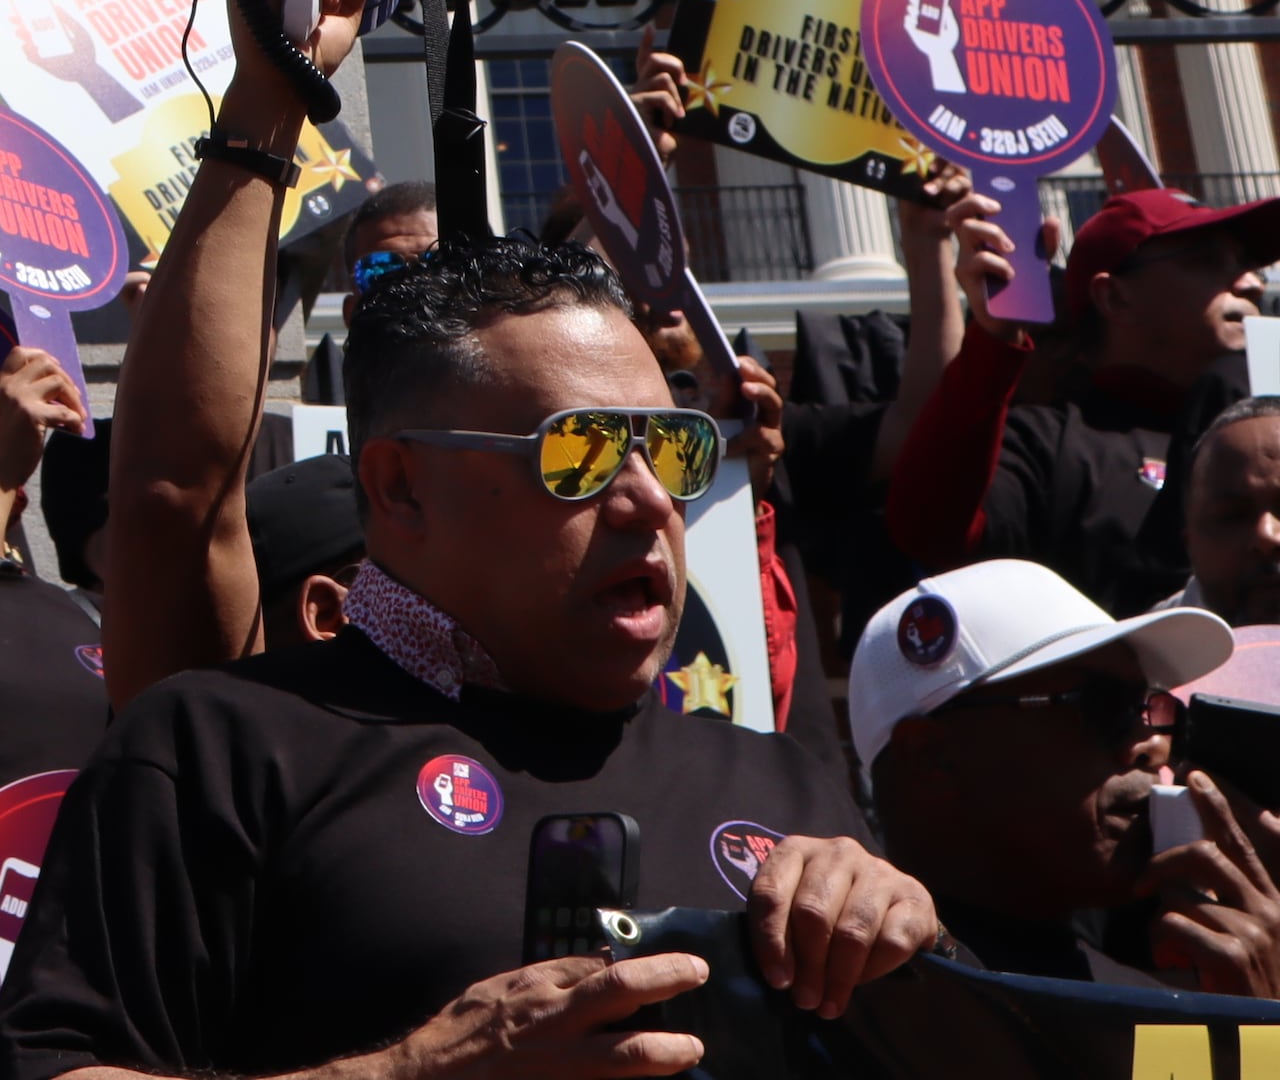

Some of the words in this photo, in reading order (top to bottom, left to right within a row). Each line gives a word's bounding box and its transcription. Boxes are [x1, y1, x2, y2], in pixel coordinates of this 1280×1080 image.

[112, 14, 207, 81] UNION
[739, 24, 840, 79] DRIVERS
[962, 17, 1066, 59] DRIVERS
[732, 52, 760, 84] IN
[772, 63, 816, 101] THE
[828, 80, 905, 130] NATIO
[965, 49, 1071, 104] UNION
[928, 104, 967, 141] IAM
[980, 127, 1030, 155] 32BJ
[1026, 114, 1069, 151] SEIU
[143, 163, 198, 211] DRIV
[15, 261, 61, 291] 32BJ
[55, 263, 92, 292] SEIU
[0, 894, 28, 918] ADU
